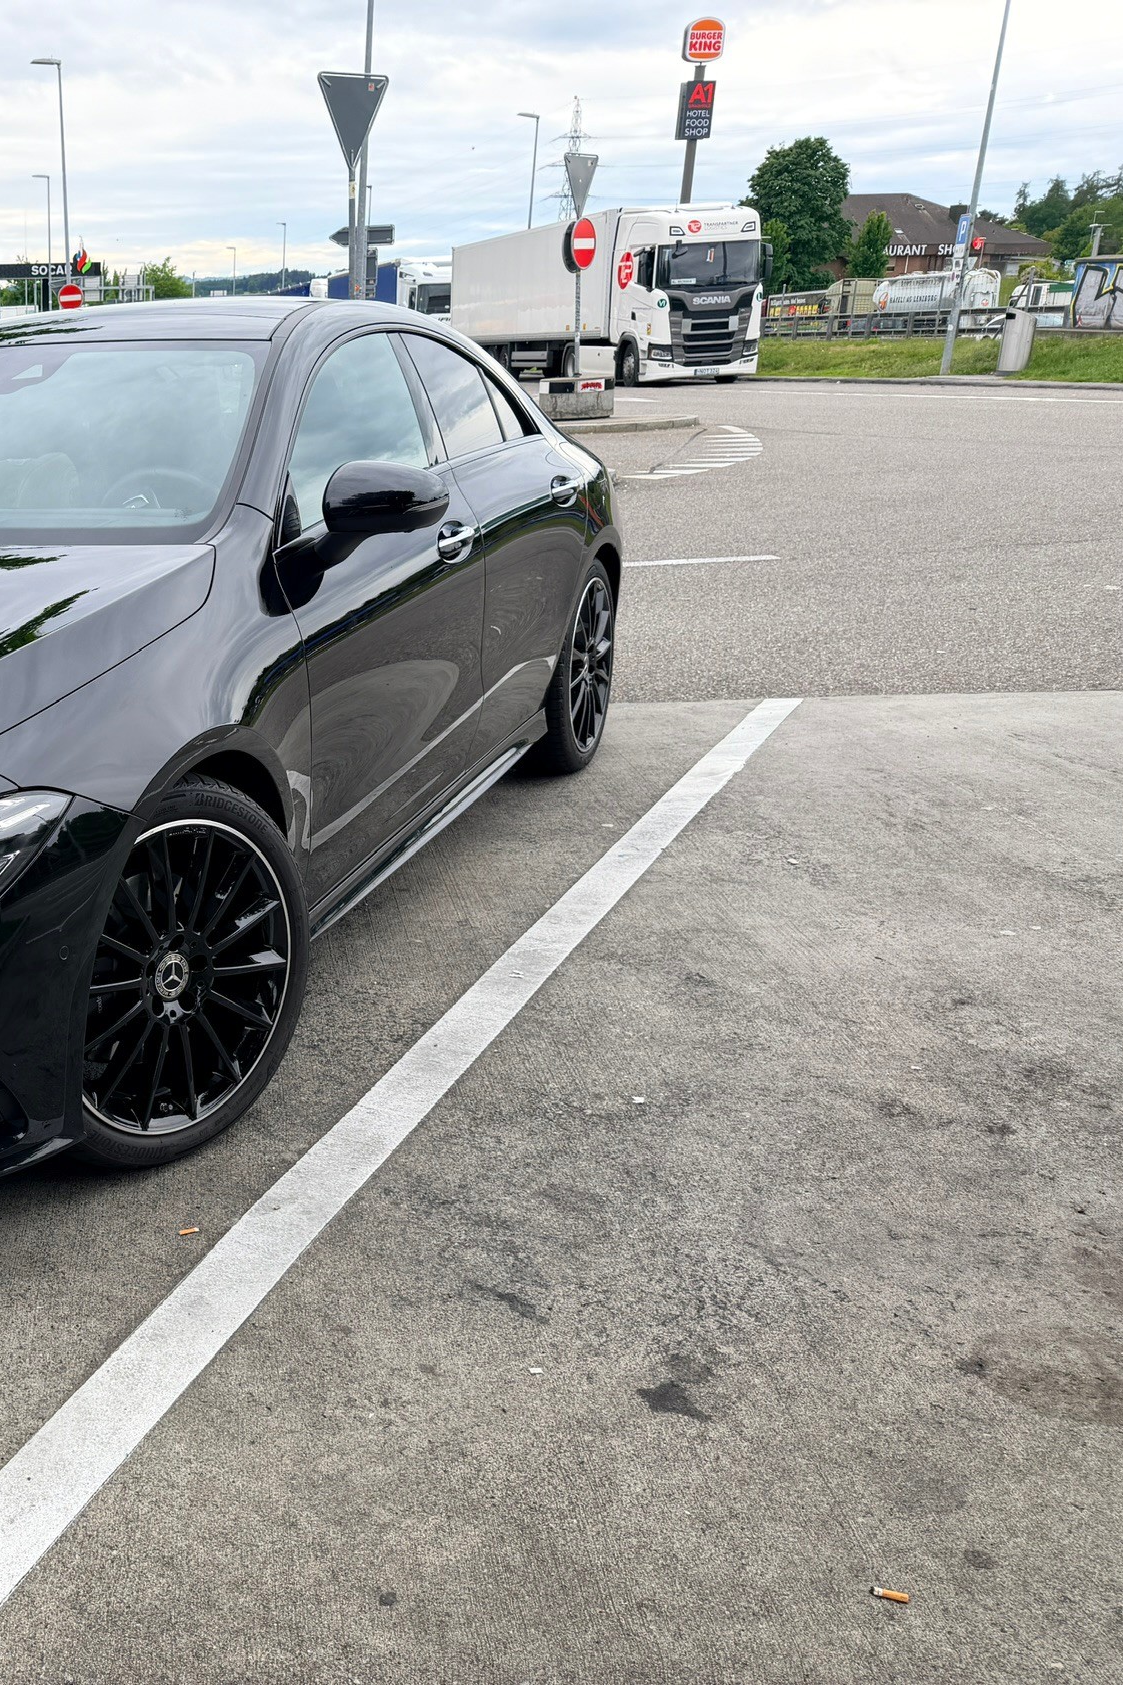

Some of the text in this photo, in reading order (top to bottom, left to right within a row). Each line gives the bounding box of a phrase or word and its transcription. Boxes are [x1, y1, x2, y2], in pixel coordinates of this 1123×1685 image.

[690, 32, 722, 40] BURGER
[689, 41, 721, 51] KING
[689, 82, 714, 103] A1
[685, 119, 709, 127] FOOD
[684, 128, 708, 136] SHOP
[958, 220, 967, 242] P
[882, 244, 927, 256] AURANT
[938, 244, 956, 256] SH
[692, 295, 731, 305] SCANIA
